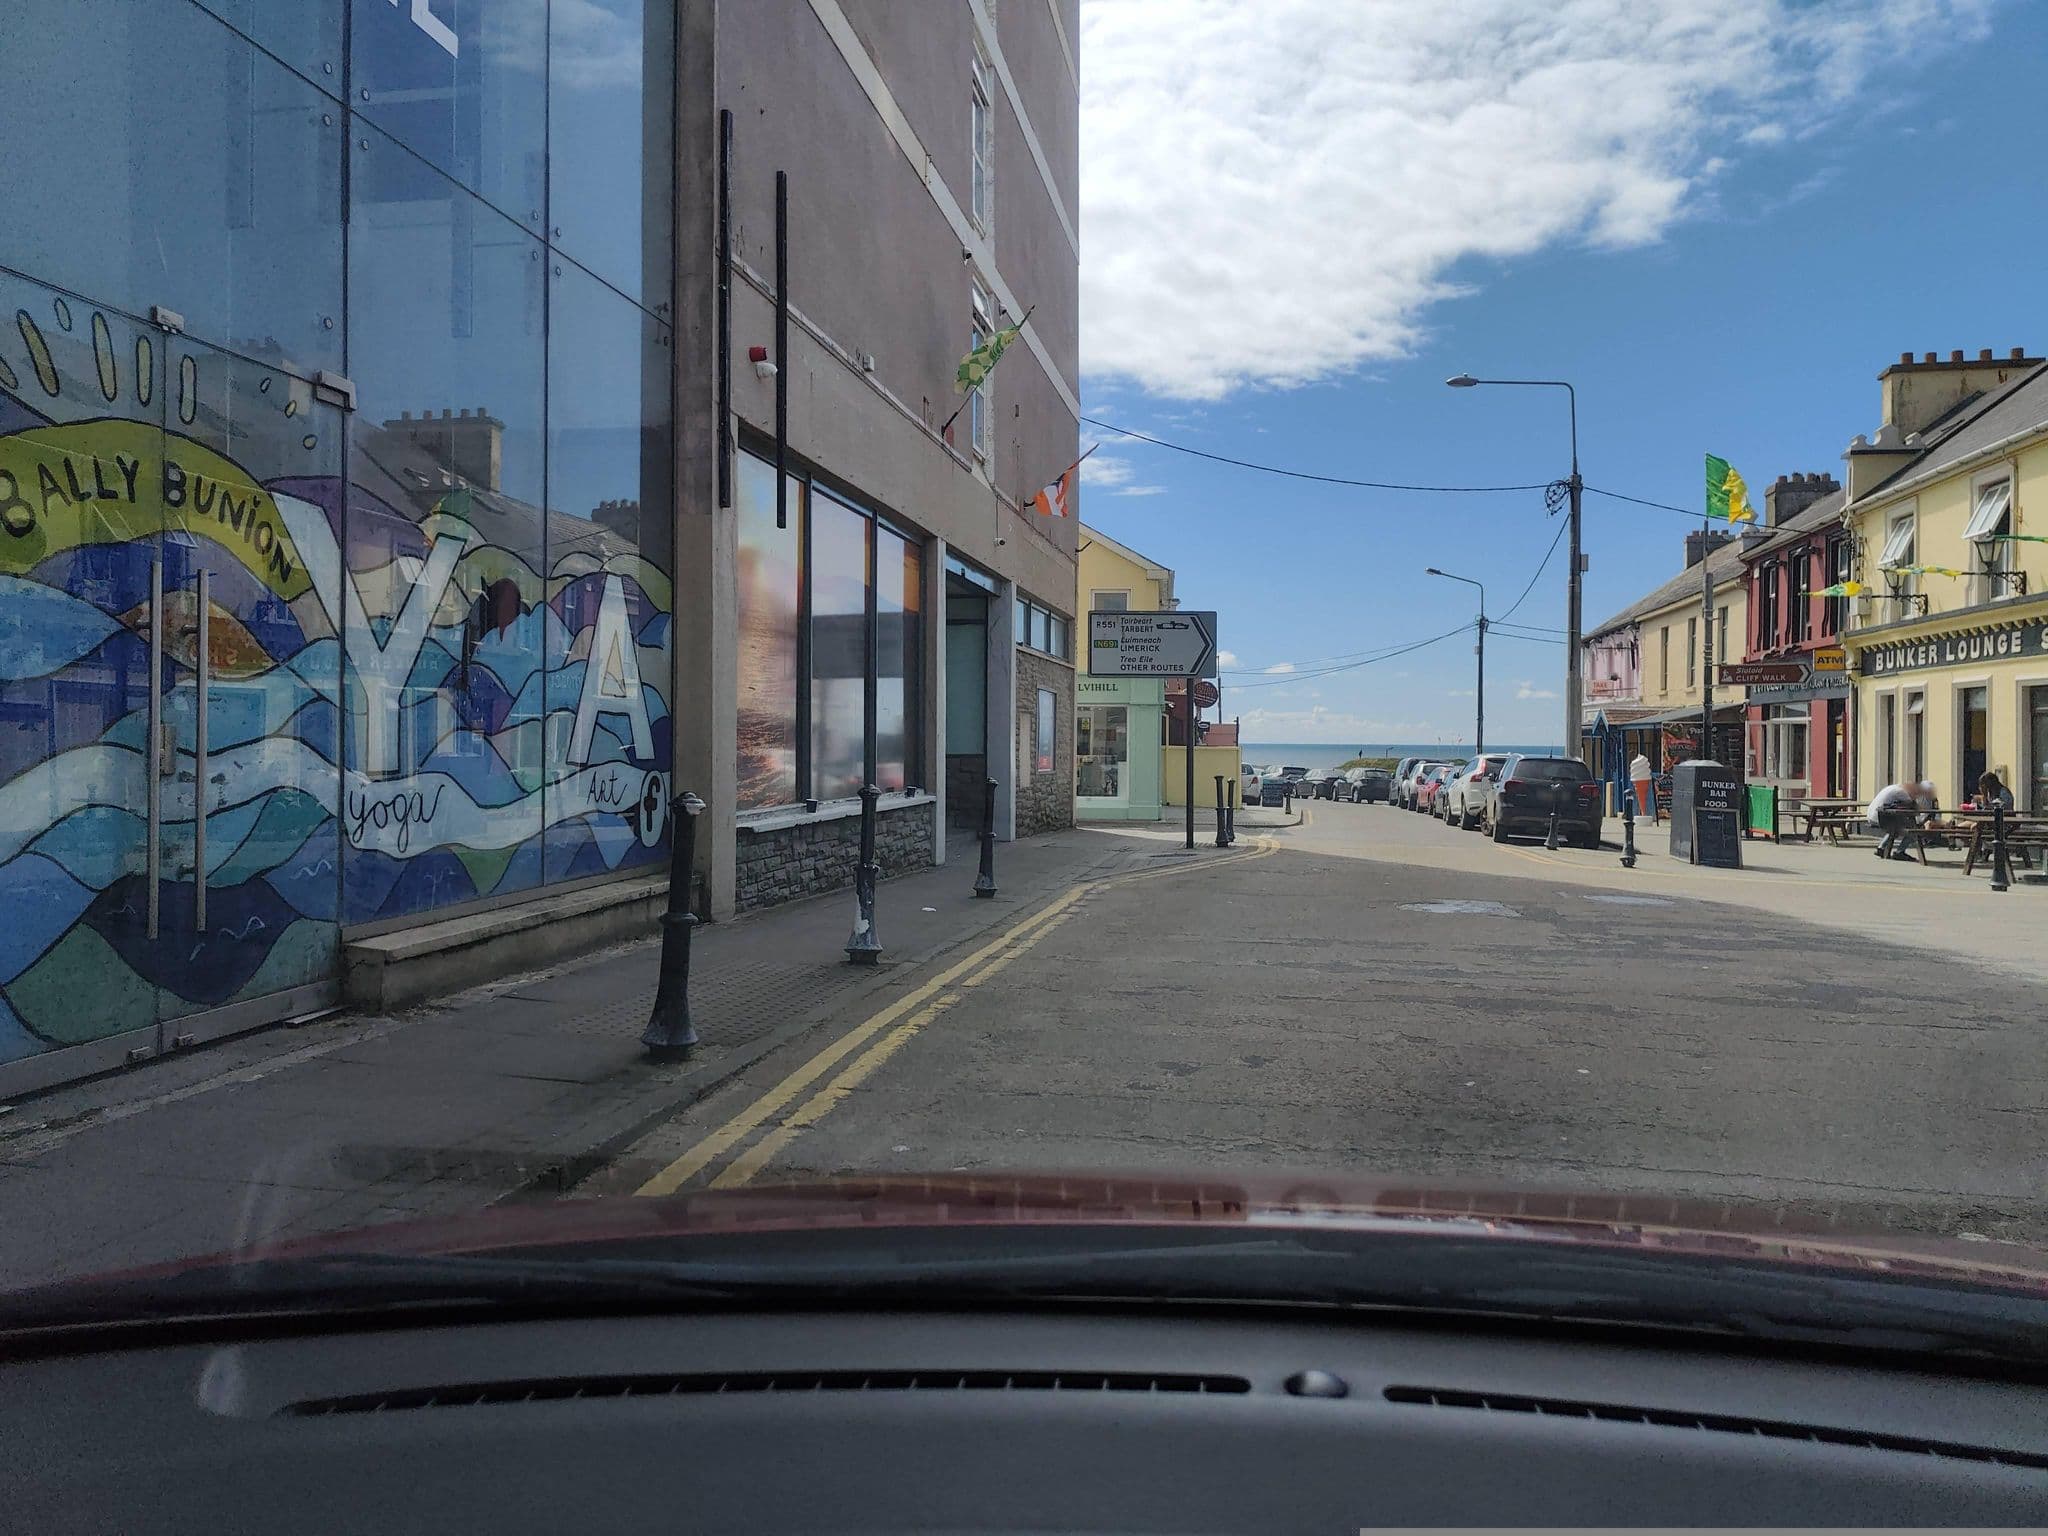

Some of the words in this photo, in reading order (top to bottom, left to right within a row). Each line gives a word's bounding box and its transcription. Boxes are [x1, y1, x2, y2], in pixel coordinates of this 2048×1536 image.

[1120, 625, 1153, 633] TARBERT
[1875, 644, 1938, 671] BUNKER
[1945, 631, 2022, 662] LOUNGE
[1120, 655, 1136, 663] Treo
[1139, 655, 1153, 663] Eile
[1816, 656, 1843, 665] ATM
[1120, 664, 1148, 672] OTHER
[1151, 664, 1184, 672] ROUTES
[1735, 674, 1759, 682] CLIFF
[1761, 673, 1786, 681] WALK
[1702, 780, 1736, 790] BUNKER
[1709, 788, 1726, 798] BAR
[1704, 800, 1728, 808] FOOD
